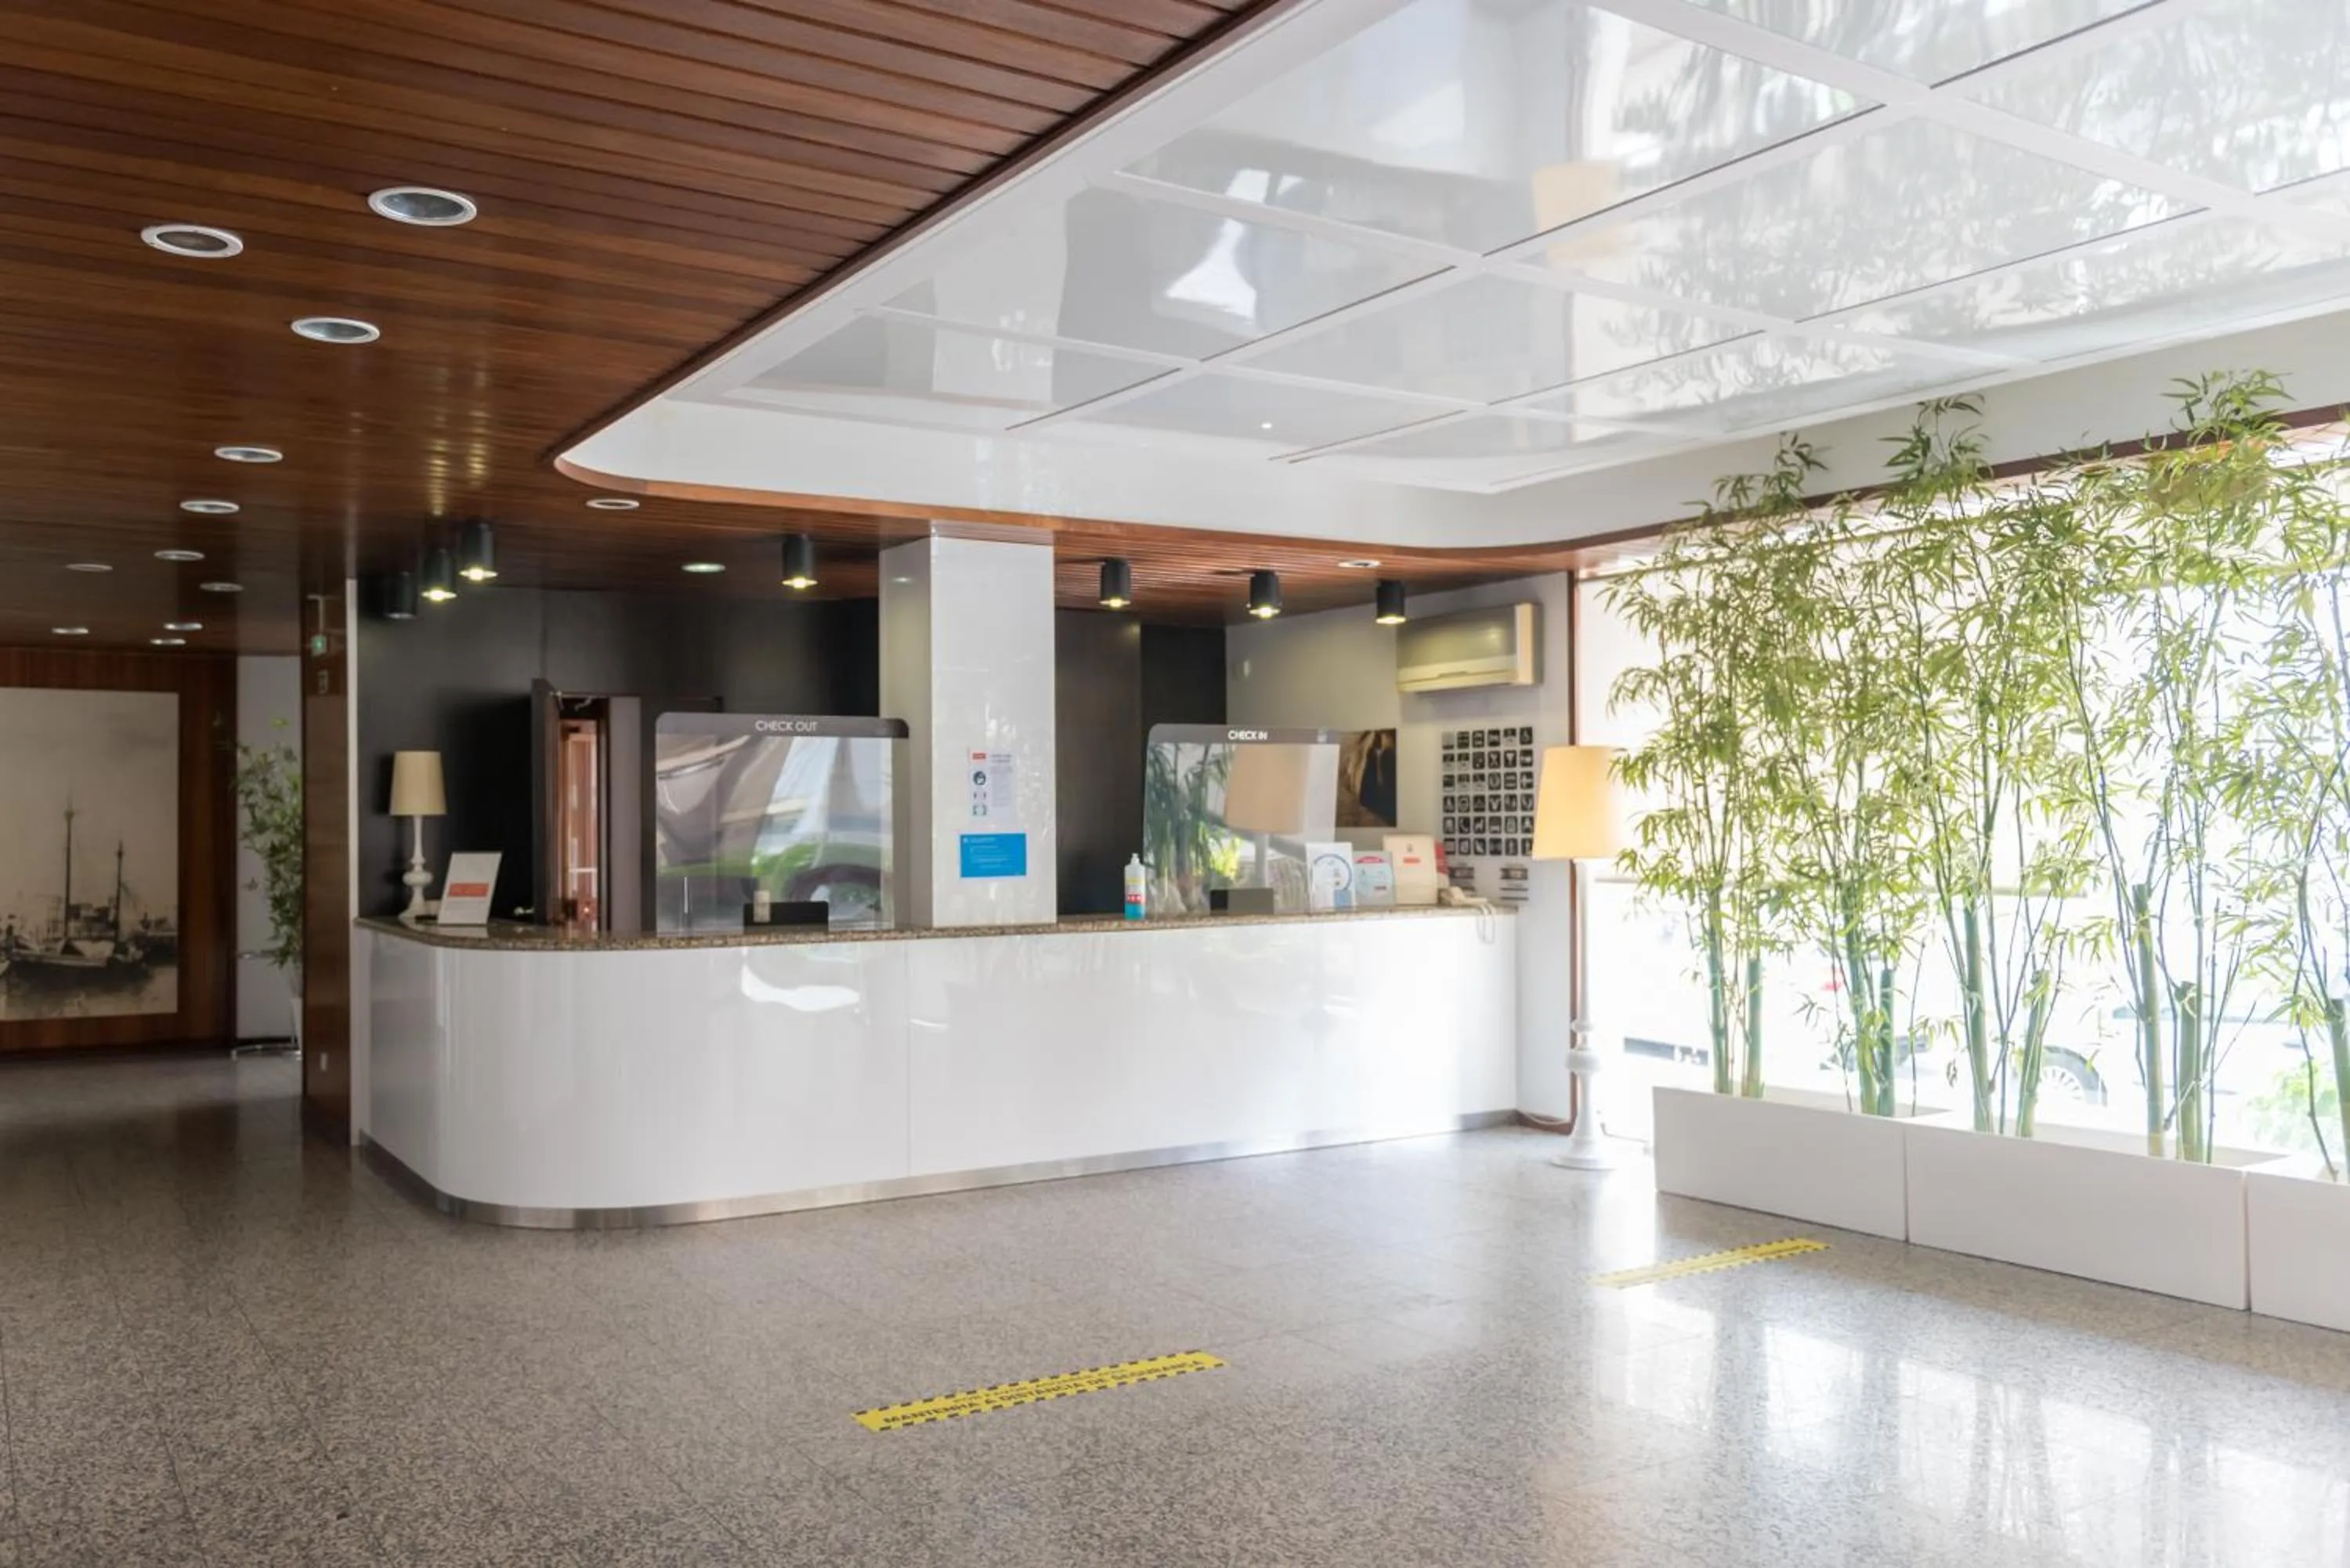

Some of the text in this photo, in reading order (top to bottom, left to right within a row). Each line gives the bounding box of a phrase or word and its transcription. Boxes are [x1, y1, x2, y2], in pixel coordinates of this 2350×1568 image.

[754, 720, 819, 732] CHECK OUT
[1227, 729, 1268, 740] CHECK IN
